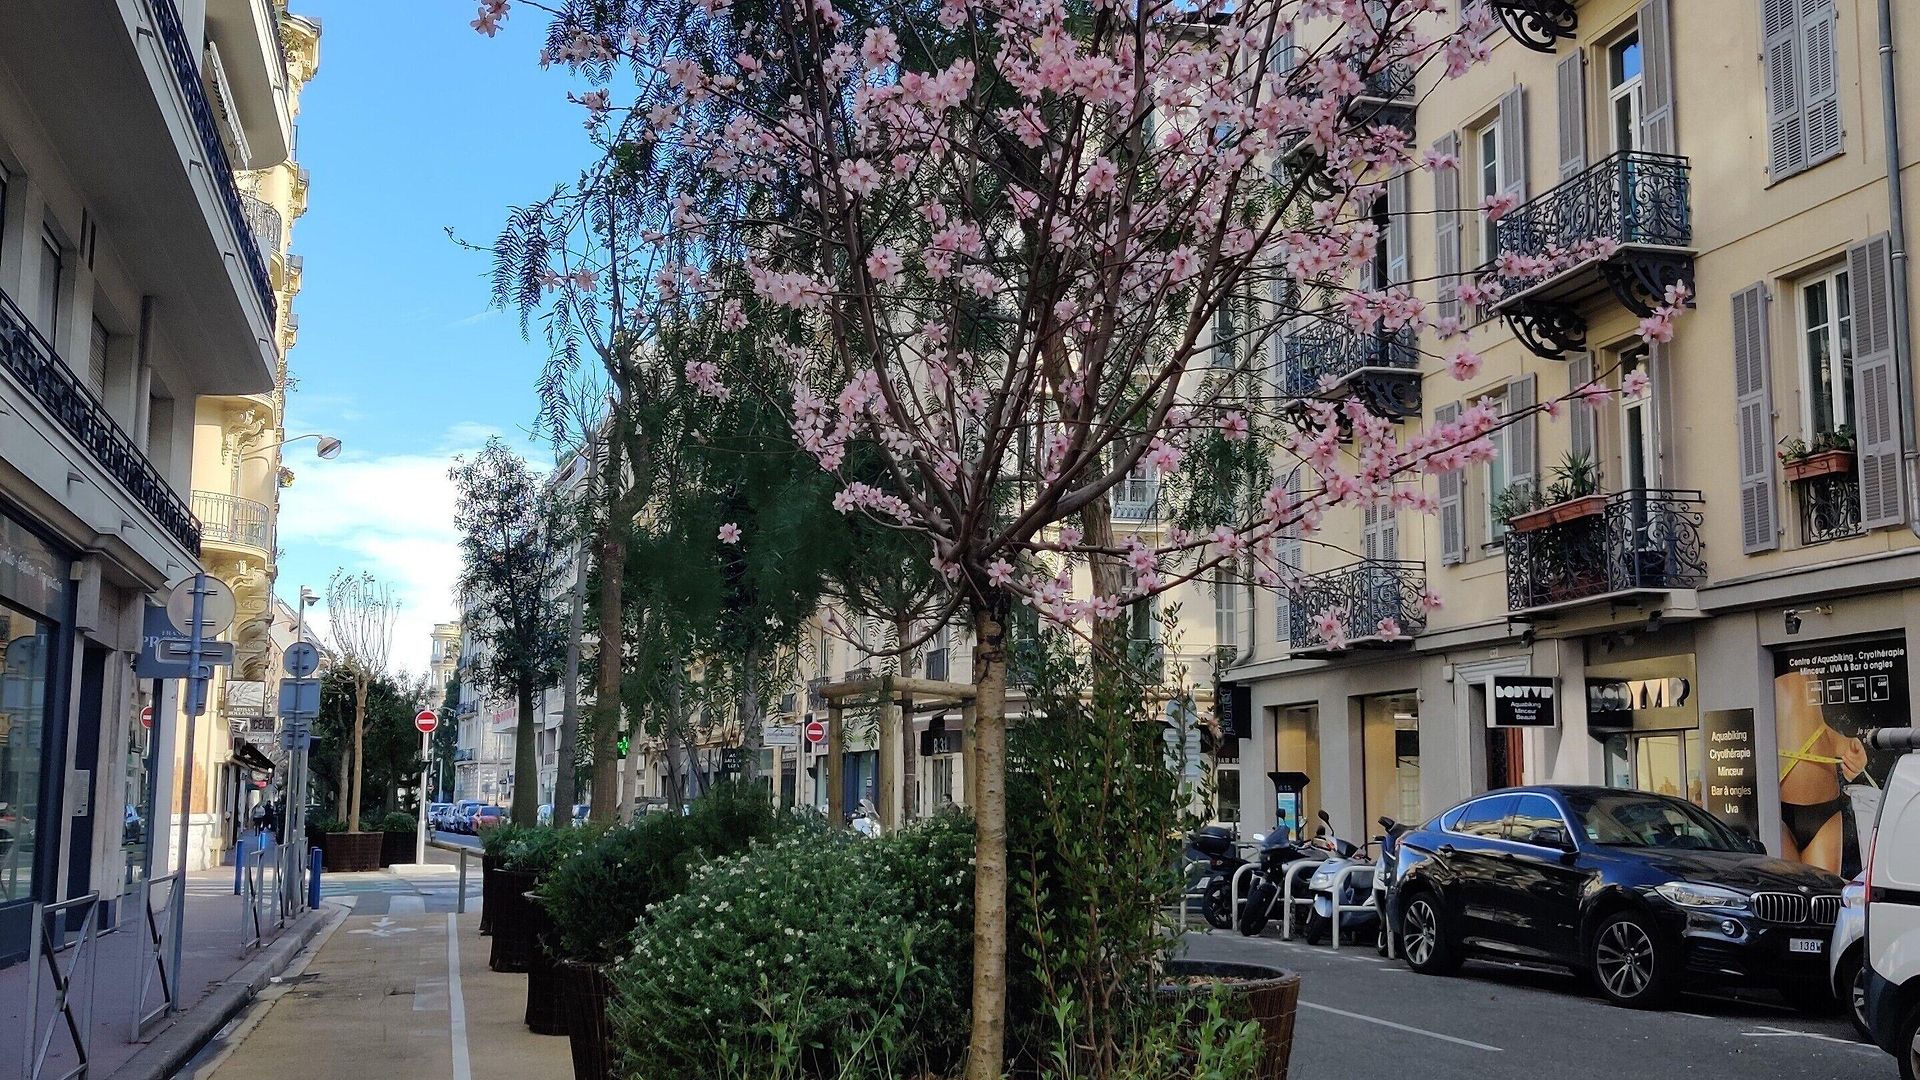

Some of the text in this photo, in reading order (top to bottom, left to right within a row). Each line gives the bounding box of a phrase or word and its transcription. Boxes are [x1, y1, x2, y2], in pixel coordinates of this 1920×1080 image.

[1789, 656, 1810, 667] Centre
[1811, 653, 1854, 666] d'Aquabiking
[1858, 648, 1904, 661] Cryothérapie
[1800, 666, 1825, 676] Minceur
[1829, 664, 1842, 674] UVA
[1843, 663, 1849, 672] &
[1850, 662, 1862, 672] Bar
[1863, 661, 1868, 670] à
[1869, 660, 1893, 671] ongles
[1496, 686, 1553, 698] BODYVIP
[1510, 701, 1541, 709] Aquabiking
[1711, 730, 1747, 743] Aquabiking
[1709, 747, 1751, 762] Cryothérapie
[1717, 766, 1744, 776] Minceur
[1711, 785, 1752, 798] Bar à ongles
[1725, 803, 1739, 814] Uva
